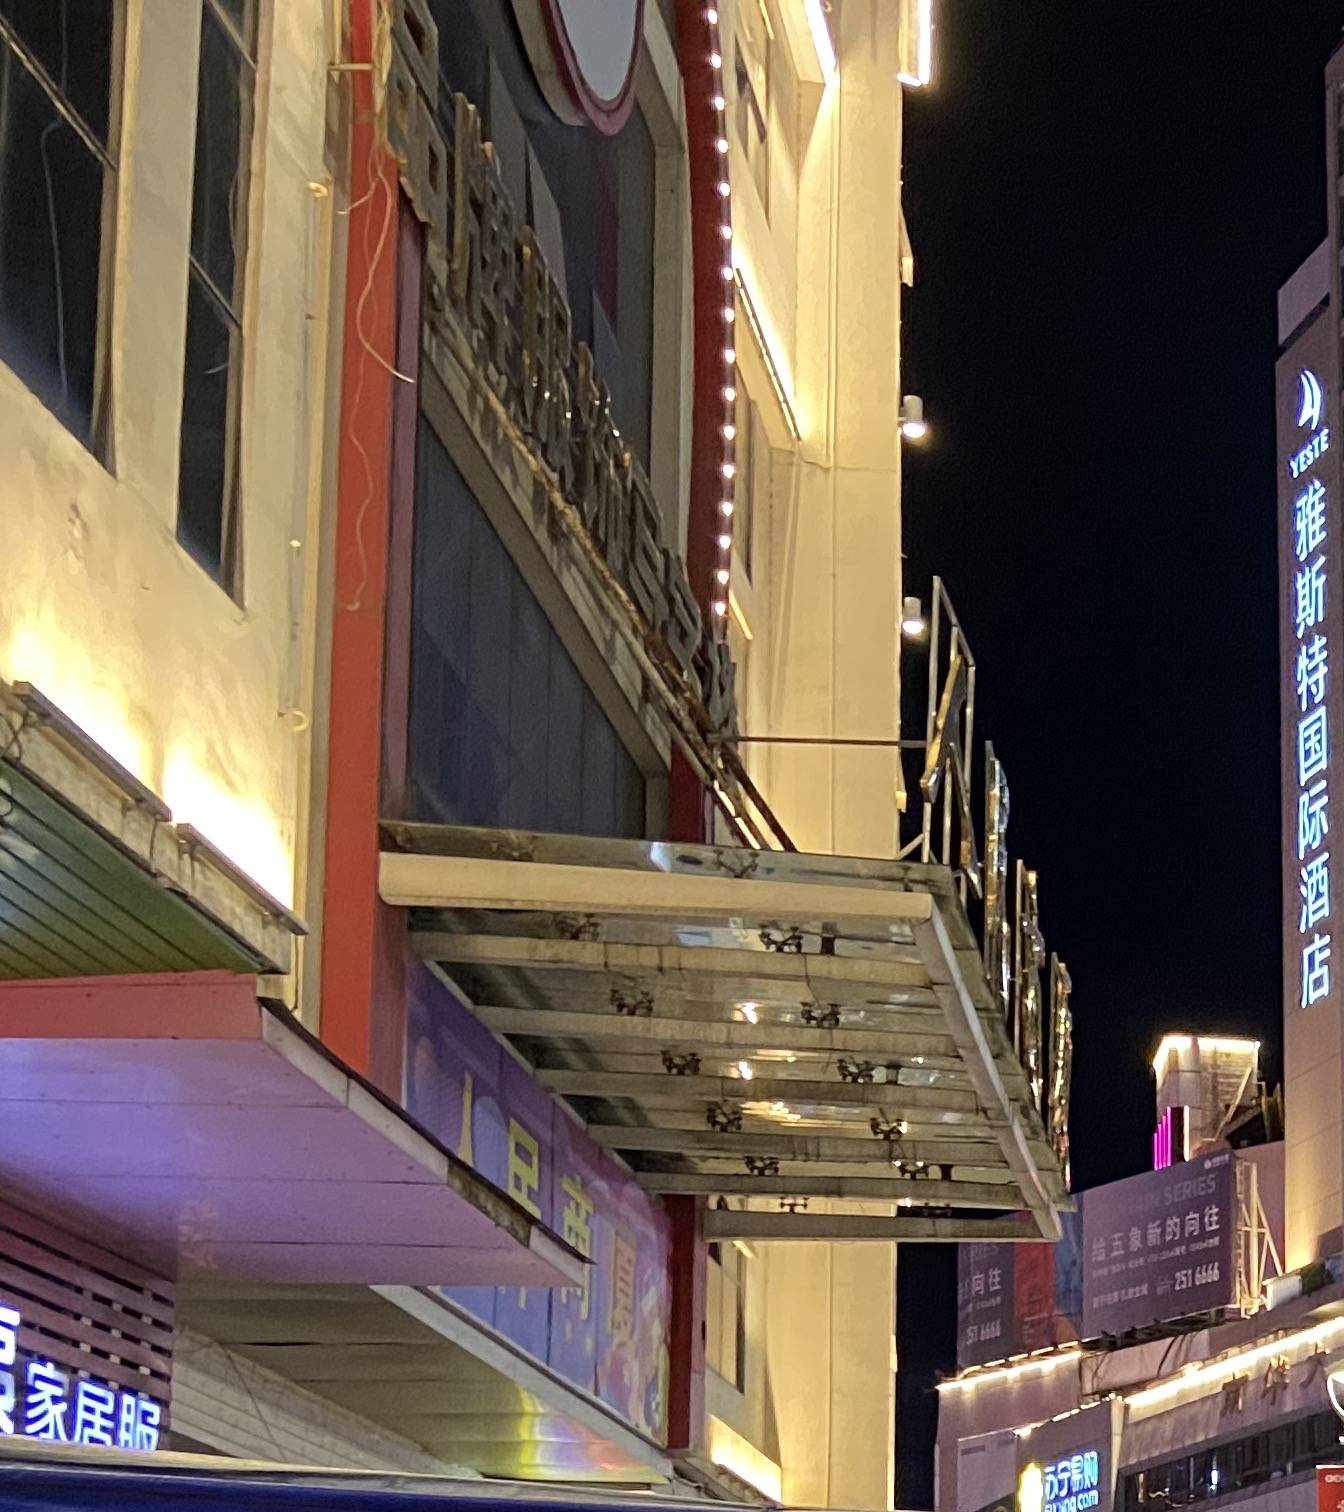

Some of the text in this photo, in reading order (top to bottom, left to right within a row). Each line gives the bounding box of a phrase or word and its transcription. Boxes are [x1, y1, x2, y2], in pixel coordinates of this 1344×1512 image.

[1289, 428, 1330, 479] YESTE
[1294, 479, 1331, 1009] 雅斯特国际酒店
[1045, 1450, 1099, 1501] 苏宁易购
